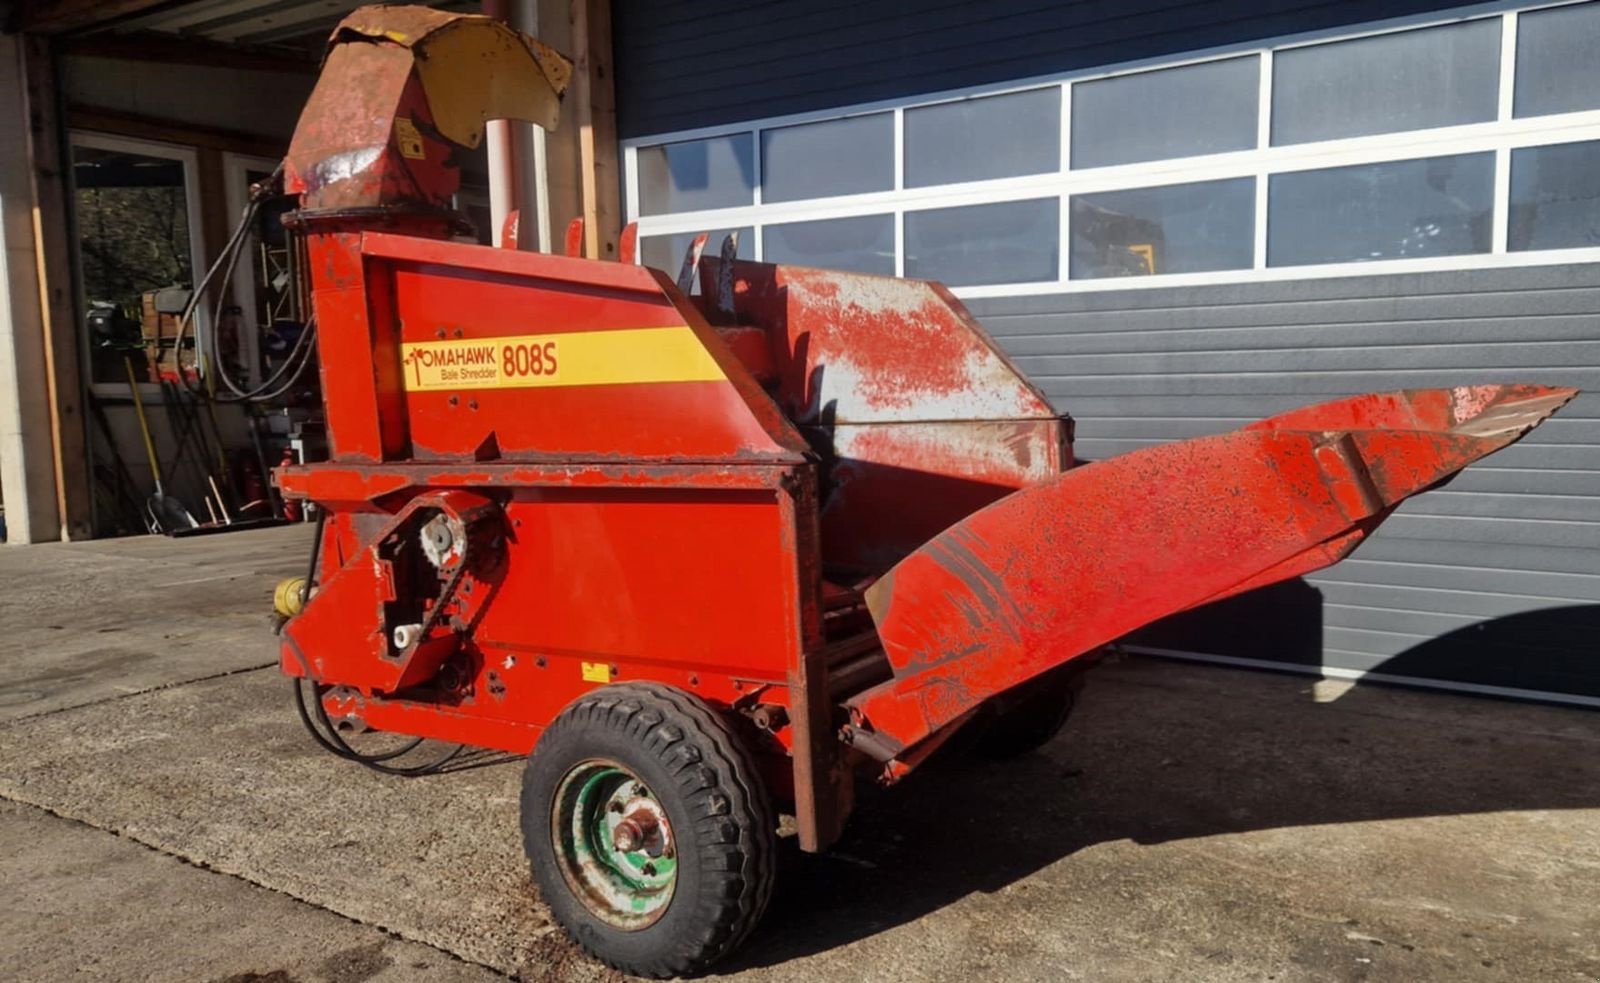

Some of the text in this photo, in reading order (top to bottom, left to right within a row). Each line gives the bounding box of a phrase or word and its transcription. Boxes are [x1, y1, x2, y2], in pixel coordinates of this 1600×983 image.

[502, 342, 557, 377] 808S
[441, 368, 497, 380] Bale Shredder
